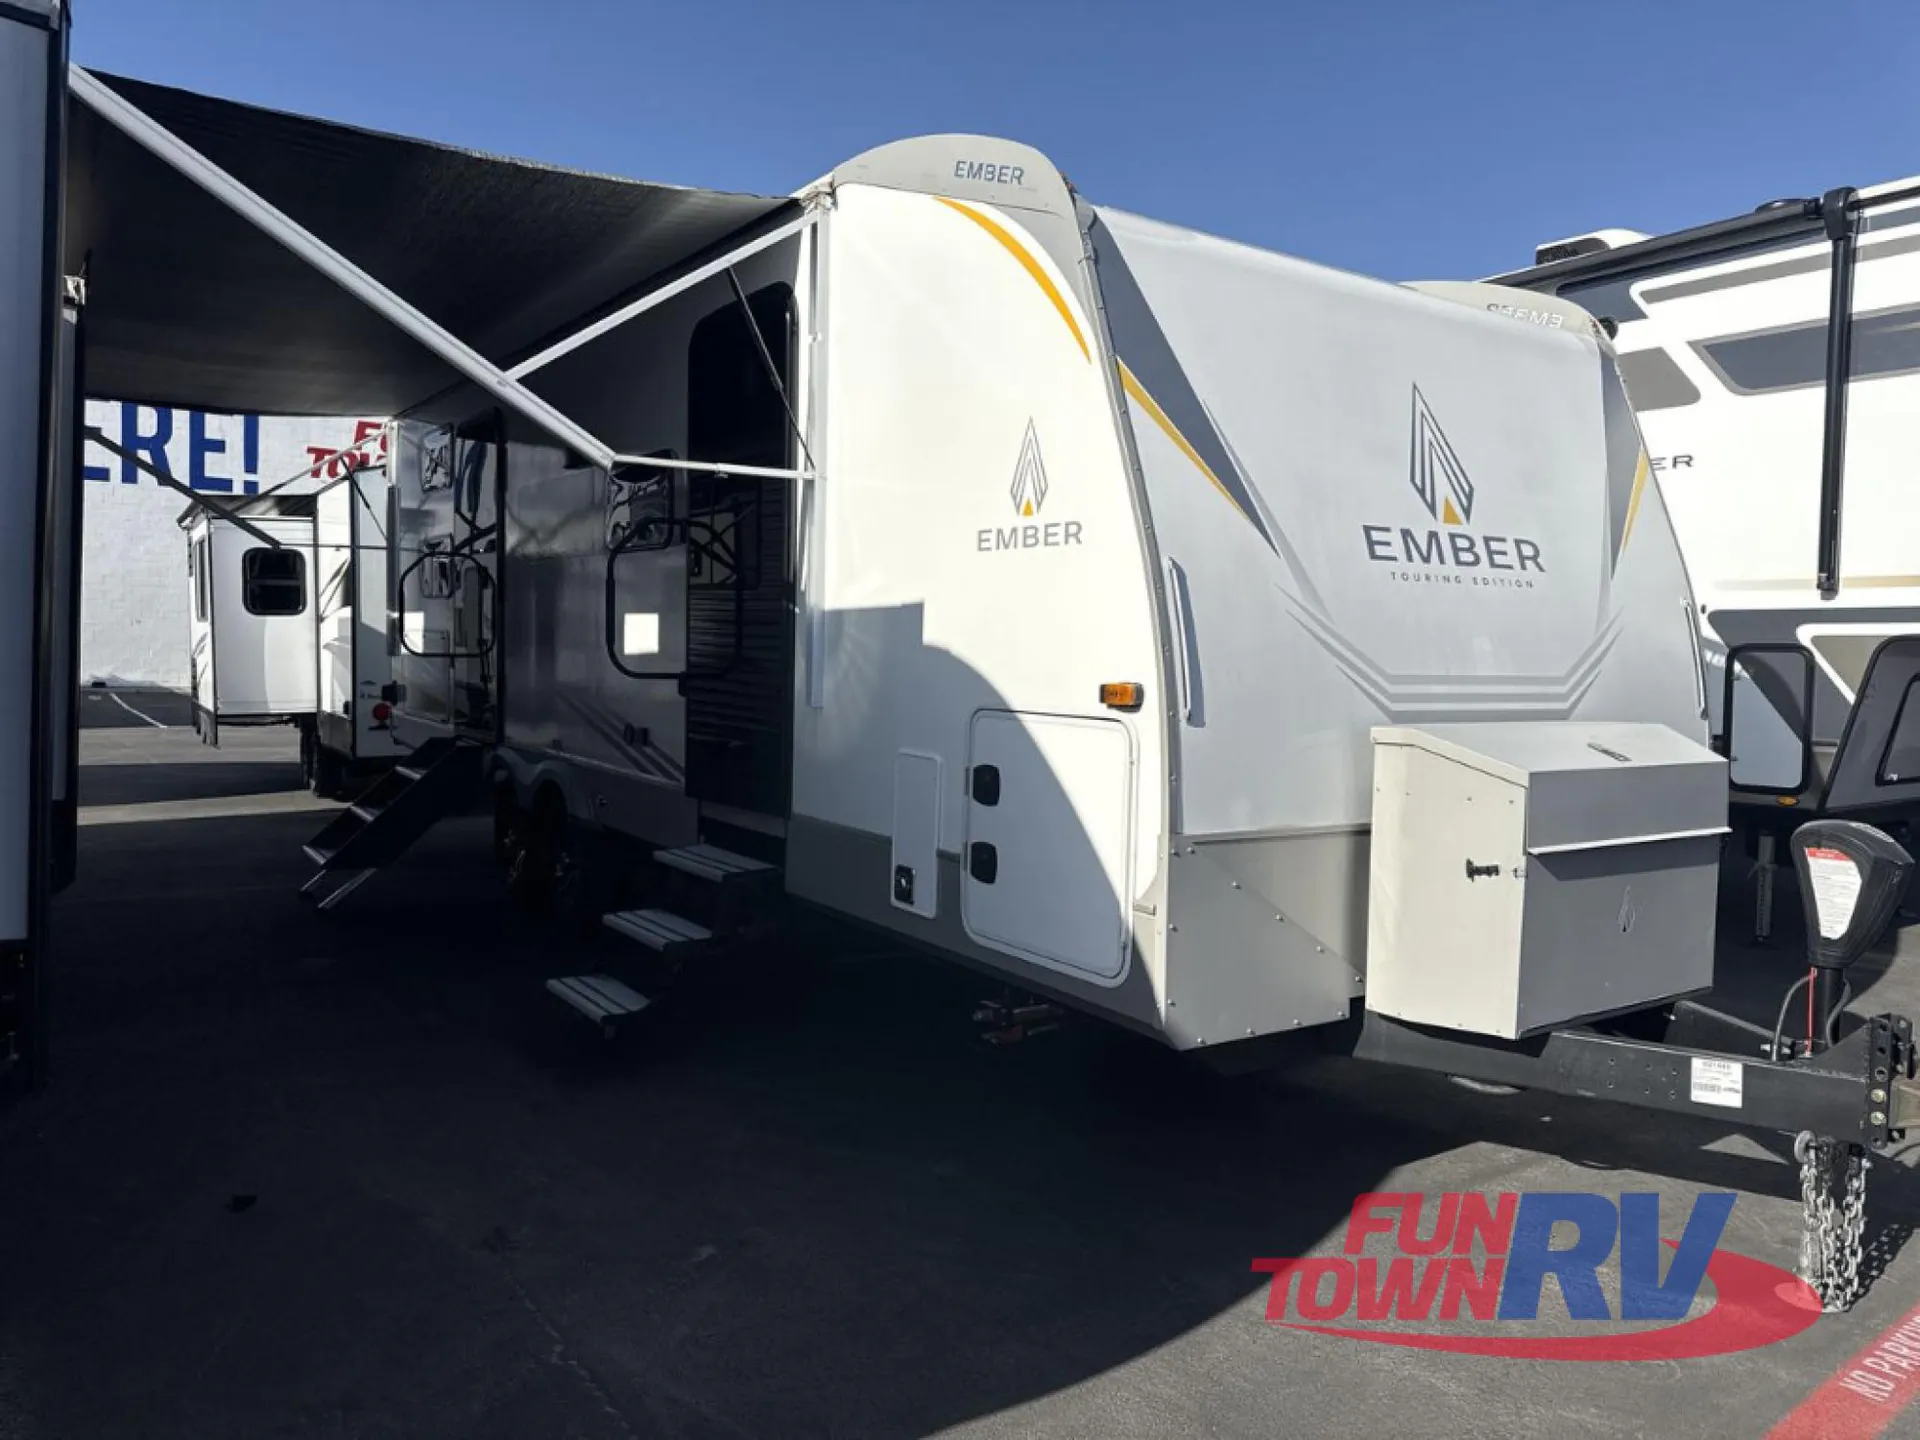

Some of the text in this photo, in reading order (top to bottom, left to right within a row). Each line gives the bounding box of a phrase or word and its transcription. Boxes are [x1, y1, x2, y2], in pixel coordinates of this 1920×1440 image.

[954, 160, 1025, 186] EMBER
[977, 521, 1082, 551] EMBER
[1362, 524, 1546, 573] EMBER
[1390, 572, 1534, 589] TOURING EDITION
[1839, 1370, 1895, 1403] NO
